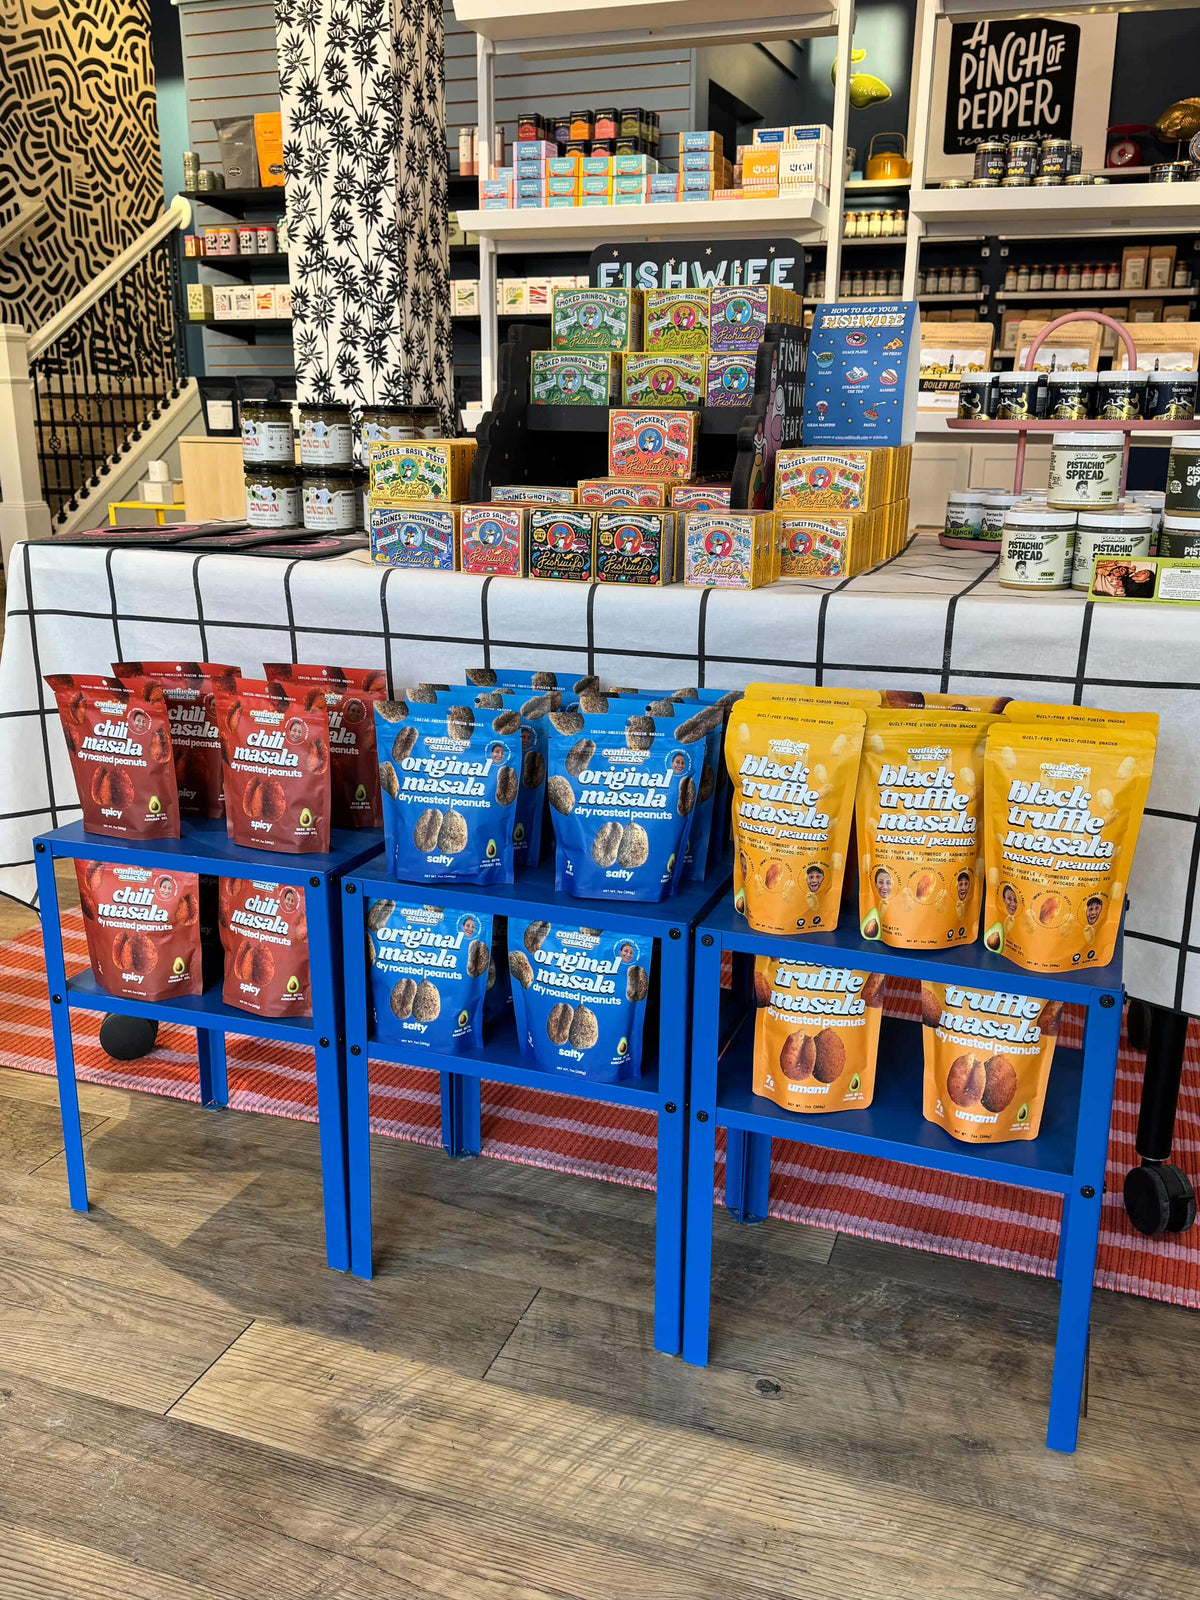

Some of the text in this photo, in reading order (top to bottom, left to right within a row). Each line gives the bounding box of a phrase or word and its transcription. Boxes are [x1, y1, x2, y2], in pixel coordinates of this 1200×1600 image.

[962, 21, 989, 49] A
[1046, 41, 1066, 65] OF
[958, 79, 1061, 130] PEPPER
[957, 136, 985, 146] Tea
[597, 257, 796, 290] FISHWIFE
[556, 293, 626, 306] SMOKED RAINBOW TROUT
[820, 313, 905, 329] FISHWIFE
[535, 356, 606, 371] SMOKED RAINBOW TROUT
[923, 381, 948, 390] BOILER
[635, 416, 667, 428] MACKEREL
[372, 447, 445, 464] MUSSELS BASIL PESTO
[778, 457, 806, 470] MUSSELS
[827, 456, 844, 465] PEPPER
[849, 462, 865, 470] GARLIC
[1066, 461, 1105, 470] PISTACHIO
[1065, 470, 1104, 480] SPREAD
[605, 488, 637, 500] MACKEREL
[250, 502, 279, 512] ONOIN
[306, 505, 333, 515] ONOIN
[372, 514, 452, 530] SARDINES PRESERVED LEMON
[467, 512, 516, 525] SMOKED SALMON
[808, 522, 825, 531] PEPPER
[830, 528, 846, 537] GARLIC
[1008, 540, 1044, 549] PISTACHIO
[1093, 543, 1133, 553] PISTACHIO
[1007, 550, 1043, 561] SPREAD
[168, 705, 206, 722] chili
[94, 720, 128, 739] chili
[169, 721, 219, 738] asala
[82, 736, 143, 756] masala
[191, 739, 221, 749] peanuts
[247, 730, 286, 750] chili
[233, 746, 299, 767] masala
[330, 746, 359, 756] eanuts
[603, 748, 650, 758] confusion
[907, 746, 952, 754] confusion
[913, 752, 946, 761] snacks
[78, 751, 147, 767] dry roasted peanuts
[401, 754, 494, 778] original
[231, 761, 302, 778] dry roasted peanuts
[739, 754, 810, 783] black
[877, 764, 955, 788] black
[578, 766, 673, 789] original
[401, 776, 486, 797] masala
[741, 778, 820, 807] truffle
[1007, 780, 1091, 810] black
[399, 793, 491, 809] dry roasted peanuts
[578, 789, 667, 809] masala
[879, 787, 970, 811] truffle
[101, 807, 122, 819] spicy
[574, 807, 673, 821] dry roasted peanuts
[738, 801, 830, 829] masala
[1007, 806, 1105, 835] truffle
[250, 820, 273, 833] spicy
[738, 820, 829, 842] roasted peanuts
[877, 811, 977, 834] masala
[875, 833, 976, 848] roasted peanuts
[1003, 830, 1114, 858] masala
[426, 854, 454, 866] salty
[1002, 850, 1111, 871] roasted peanuts
[605, 869, 634, 881] salty
[112, 886, 155, 906] chili
[98, 903, 168, 922] masala
[245, 895, 280, 916] chili
[106, 920, 173, 932] roasted peanuts
[230, 909, 289, 936] masala
[259, 931, 292, 947] peanuts
[376, 925, 464, 950] original
[378, 945, 457, 969] masala
[534, 948, 622, 974] original
[121, 971, 144, 984] spicy
[376, 961, 462, 980] dry roasted peanuts
[536, 967, 616, 995] masala
[775, 967, 864, 993] truffle
[240, 982, 261, 997] spicy
[533, 983, 622, 1006] dry roasted peanuts
[769, 990, 866, 1016] masala
[944, 985, 1041, 1019] truffle
[768, 1008, 866, 1029] dry roasted peanuts
[937, 1009, 1041, 1044] masala
[402, 1021, 428, 1034] salty
[935, 1029, 1041, 1055] dry roasted peanuts
[558, 1048, 585, 1061] salty
[787, 1083, 830, 1094] umami
[954, 1110, 999, 1124] umami
